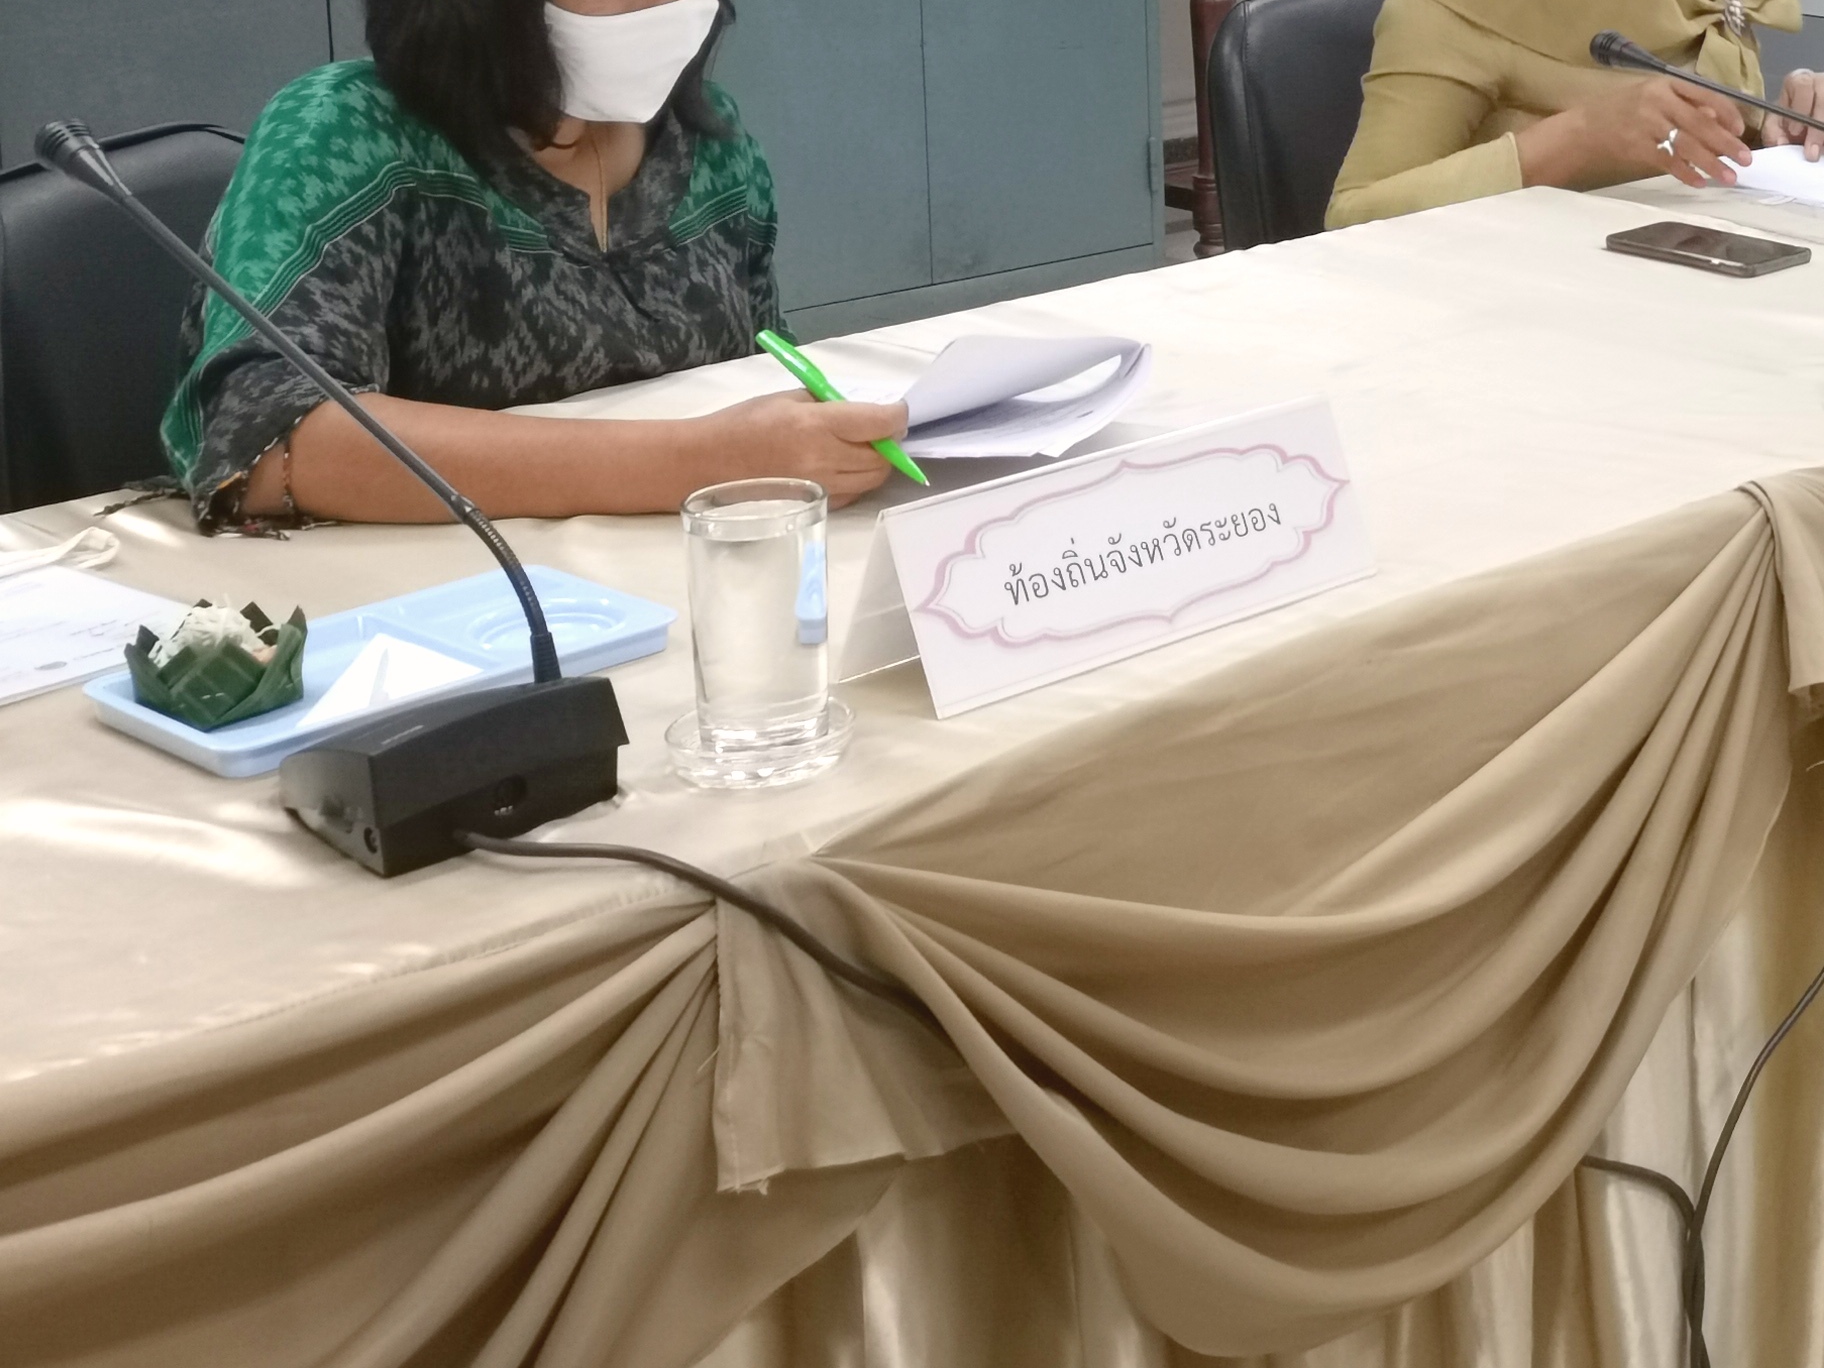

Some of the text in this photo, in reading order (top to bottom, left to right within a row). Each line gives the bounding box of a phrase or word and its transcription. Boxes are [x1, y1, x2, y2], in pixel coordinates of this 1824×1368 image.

[1003, 500, 1282, 606] ท้องถิ่นจังหวัดระยอง
